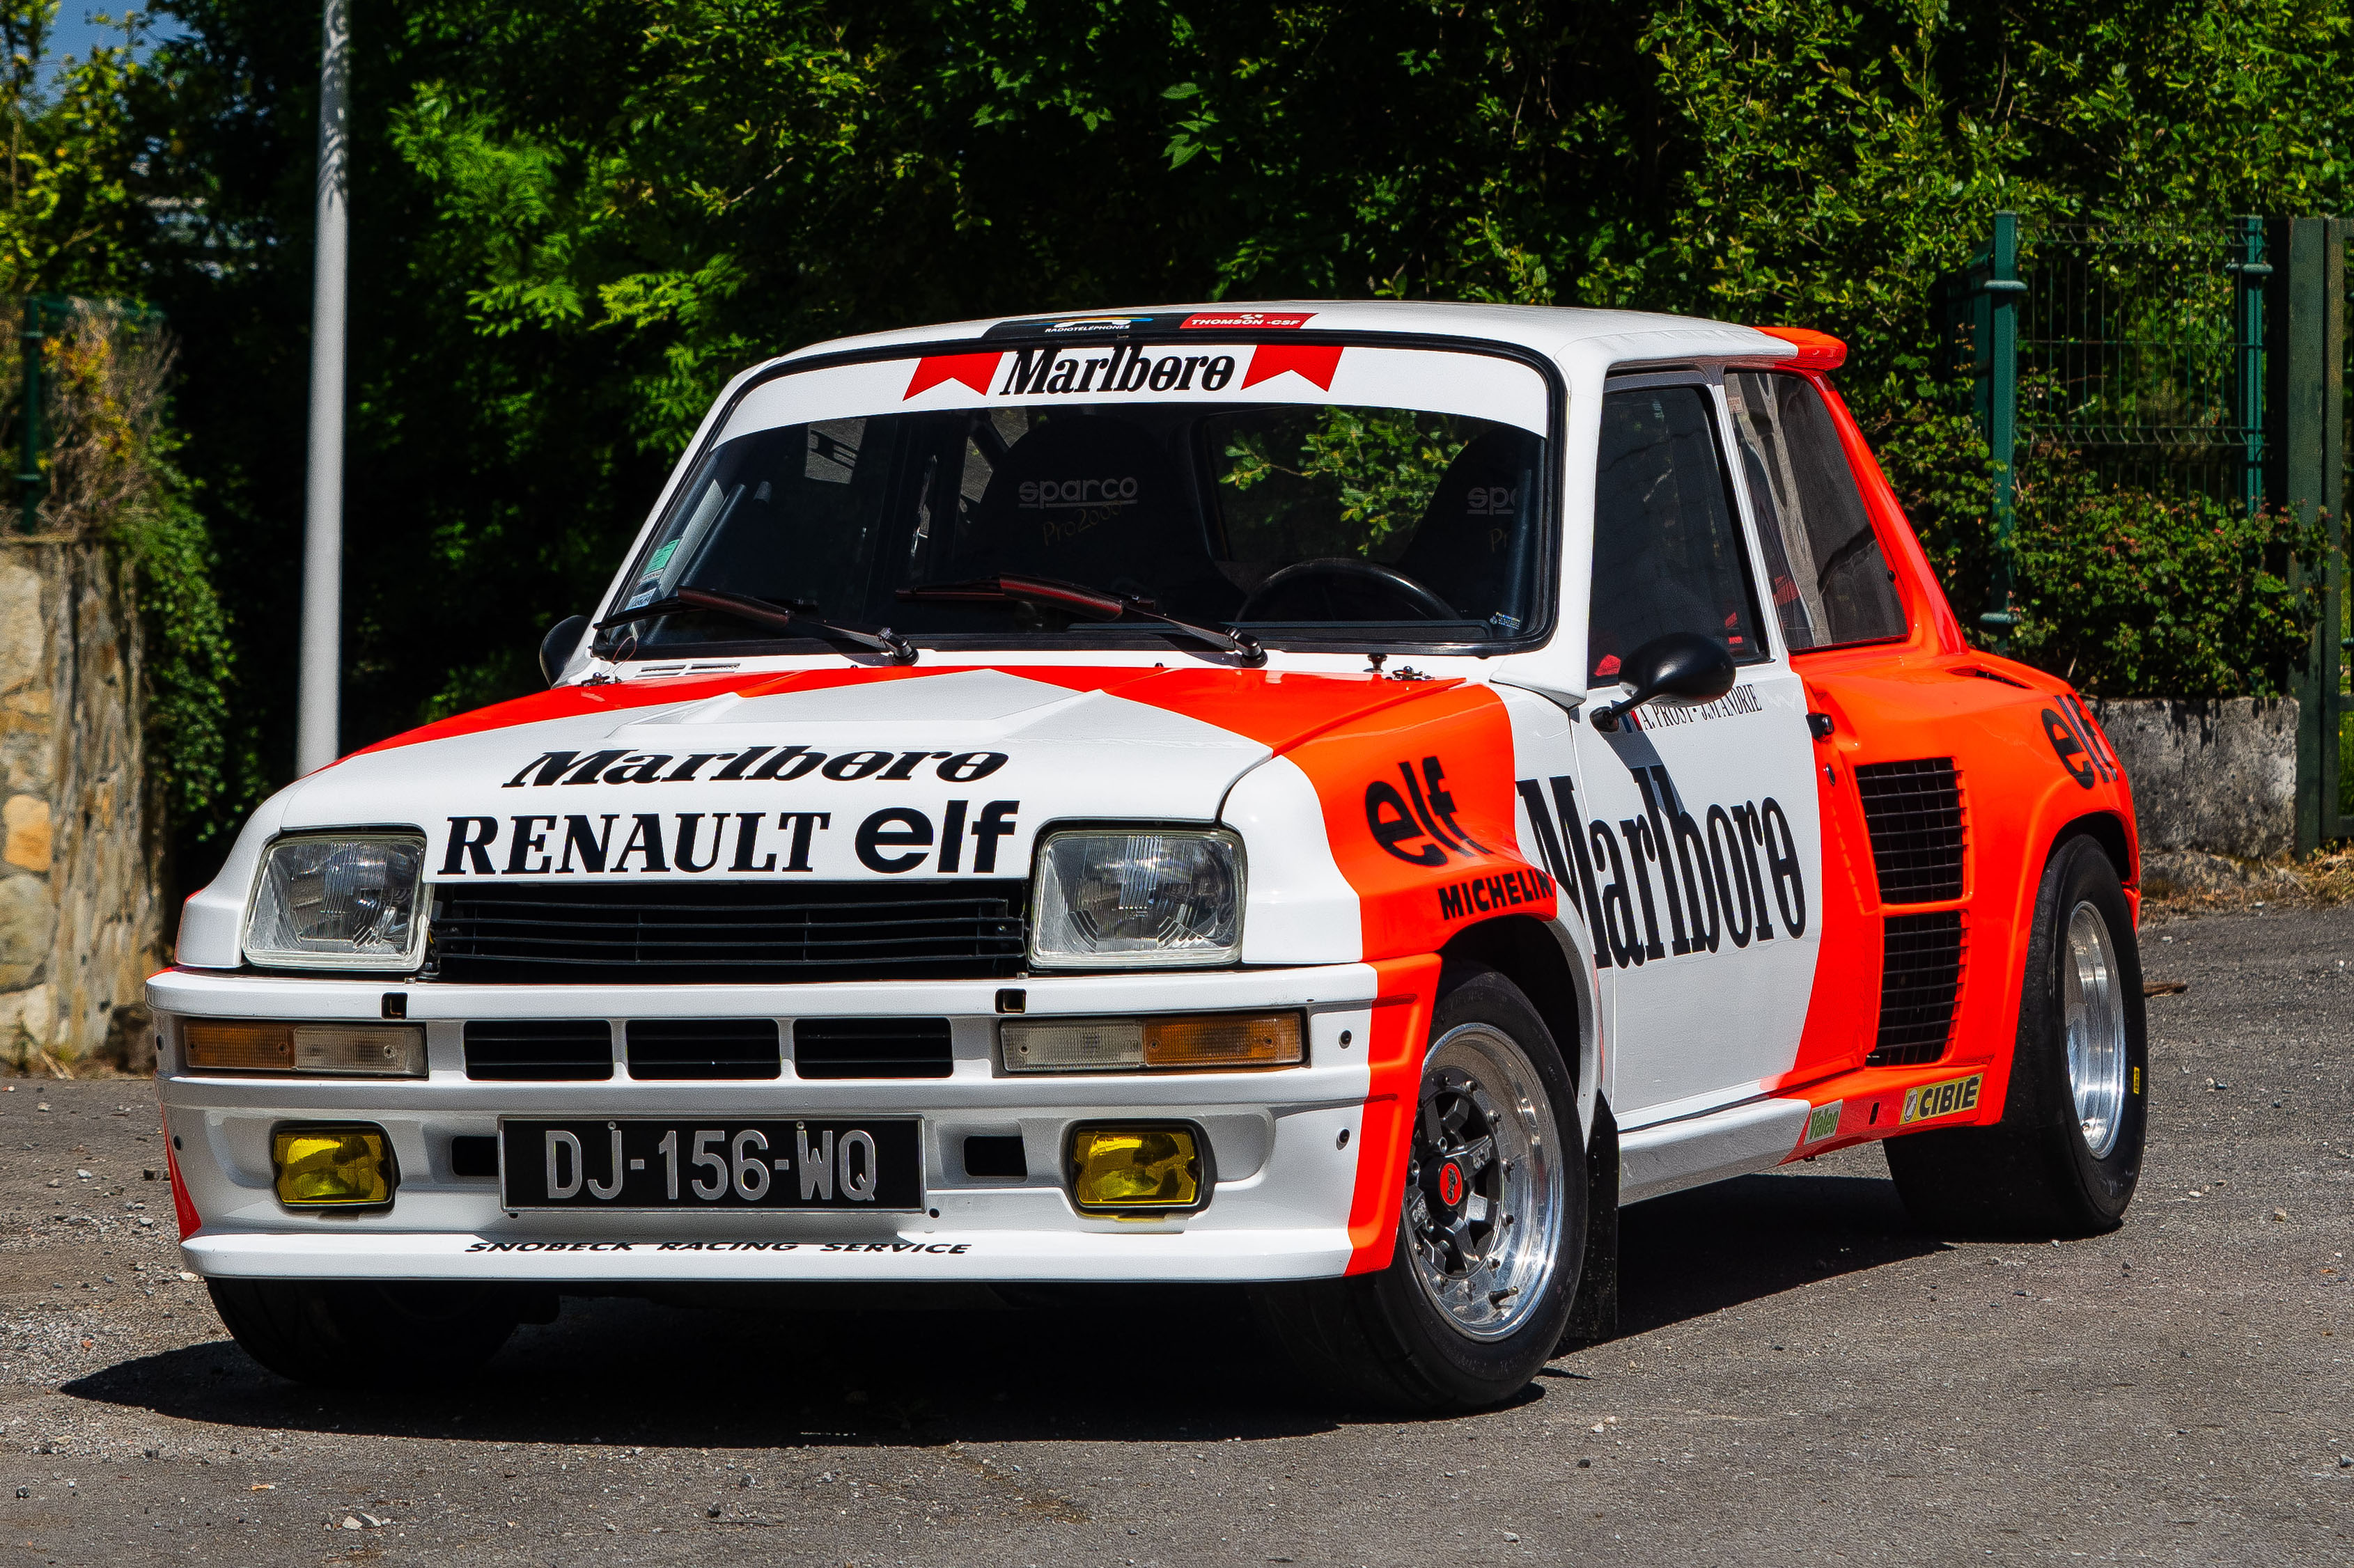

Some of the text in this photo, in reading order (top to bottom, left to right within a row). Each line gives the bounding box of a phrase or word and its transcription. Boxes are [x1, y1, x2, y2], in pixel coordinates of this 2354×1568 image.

[999, 346, 1236, 396] Marlboro
[1018, 477, 1138, 509] sparco
[1043, 499, 1122, 546] Pro2000
[2041, 693, 2119, 790] elf
[501, 746, 1009, 788] Marlboro
[1364, 756, 1495, 866] elf
[437, 800, 1019, 875] RENAULT elf
[1515, 765, 1807, 969] Marlboro
[1437, 869, 1554, 920] MICHELIN
[1919, 1076, 1979, 1118] CIBIE
[545, 1129, 875, 1201] DJ-156-WQ
[465, 1241, 972, 1254] SNOBECK RACING SERVICE
